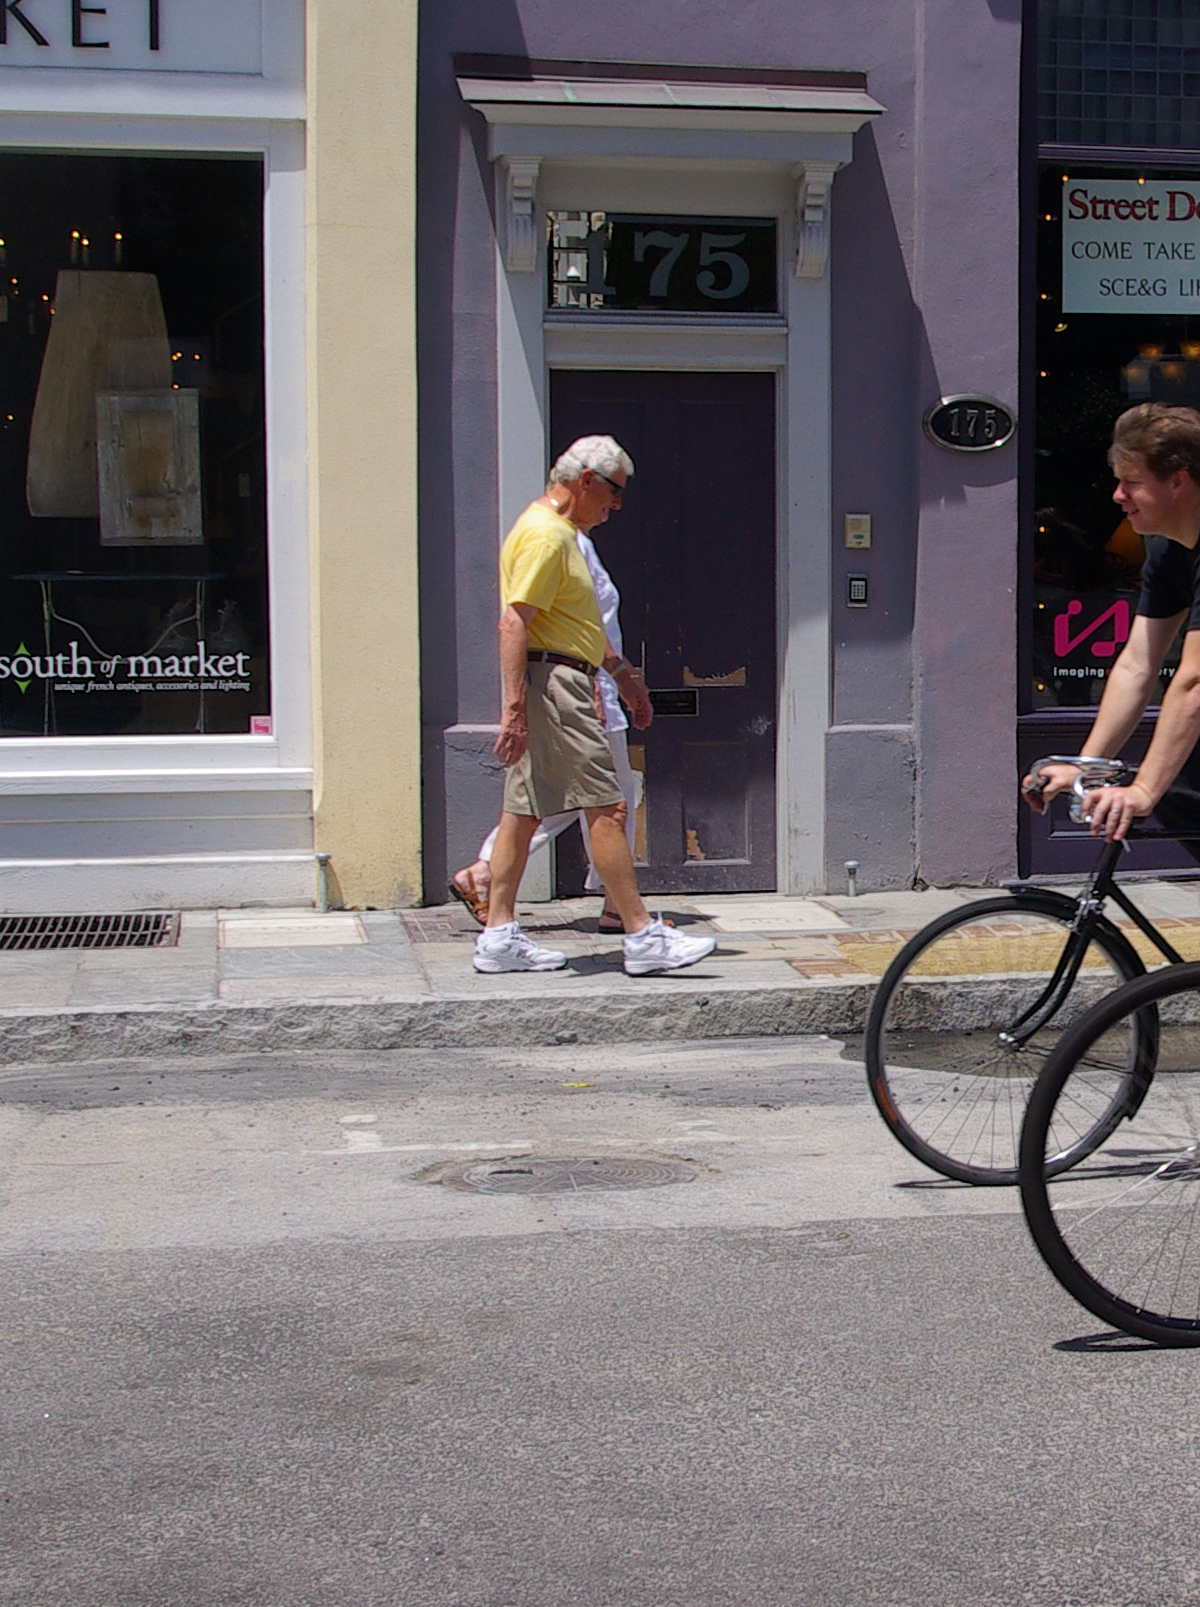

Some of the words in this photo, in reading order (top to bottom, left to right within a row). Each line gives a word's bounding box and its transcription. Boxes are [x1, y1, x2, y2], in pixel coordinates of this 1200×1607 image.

[1068, 188, 1160, 221] Street
[1071, 241, 1133, 260] COME
[1144, 242, 1195, 261] TAKE
[1099, 278, 1167, 296] SCE&G
[949, 408, 997, 438] 175
[0, 641, 95, 678] south
[100, 655, 122, 678] of
[127, 640, 250, 677] market
